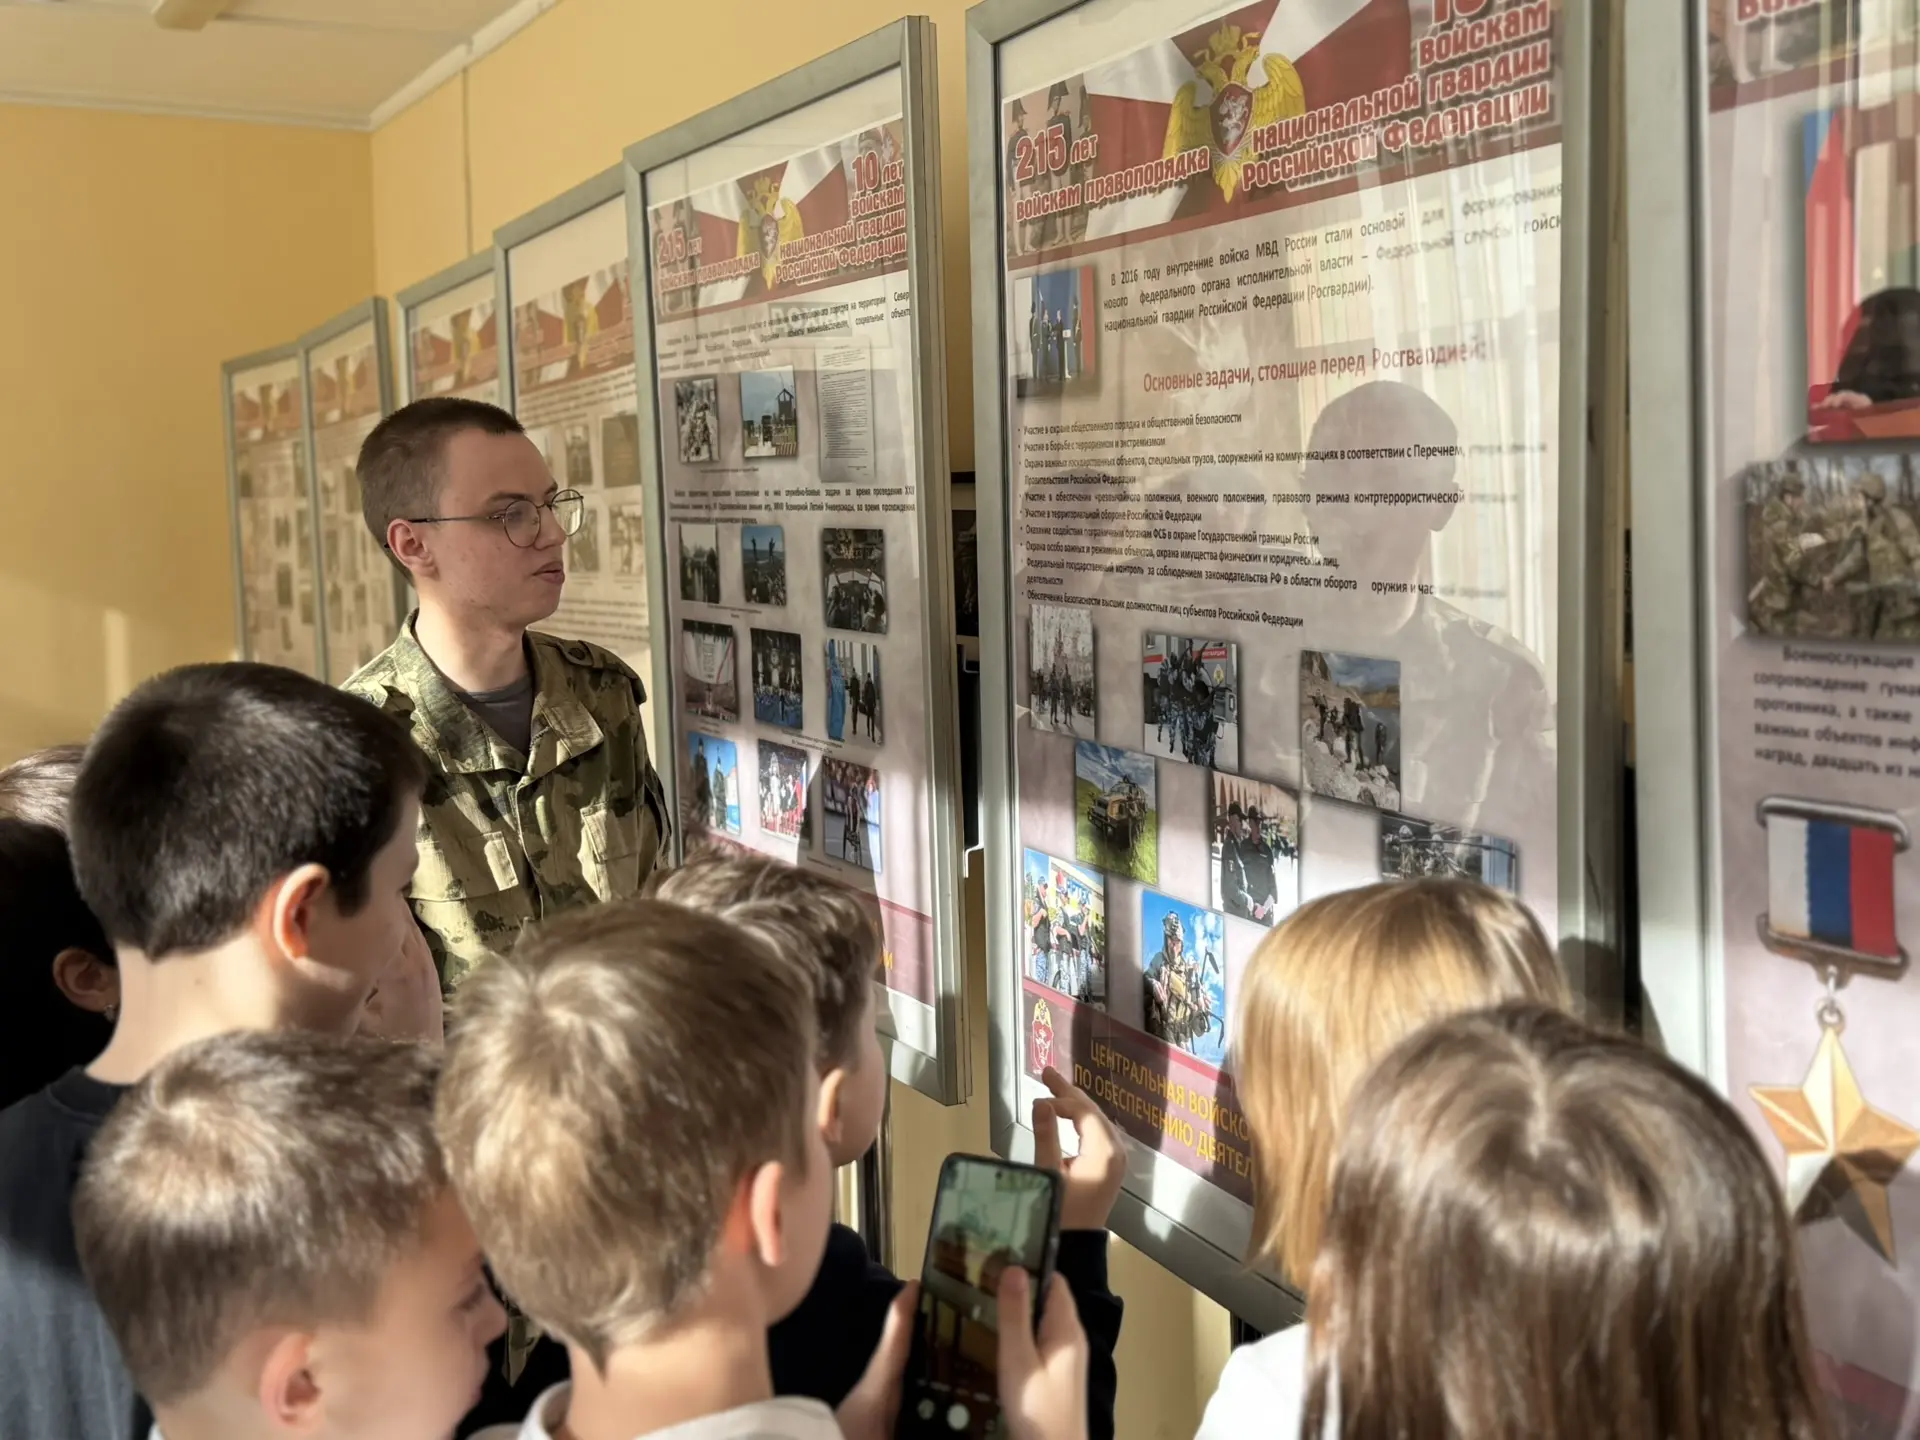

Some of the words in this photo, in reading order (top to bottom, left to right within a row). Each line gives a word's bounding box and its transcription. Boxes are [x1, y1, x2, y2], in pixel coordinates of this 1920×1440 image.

[1418, 0, 1550, 68] войскам
[1253, 74, 1421, 153] национальной
[1427, 38, 1550, 104] гвардии
[851, 151, 879, 192] 10
[882, 159, 904, 183] лет
[1016, 124, 1066, 181] 215
[1071, 134, 1098, 165] лет
[1242, 126, 1377, 191] Российской
[851, 185, 905, 218] войскам
[1016, 183, 1081, 222] войскам
[1085, 146, 1210, 203] правопорядка
[657, 228, 687, 266] 215
[780, 219, 855, 260] национальной
[857, 209, 906, 238] гвардии
[1121, 269, 1138, 284] 2016
[1143, 267, 1160, 281] году
[1166, 256, 1214, 277] внутренние
[1219, 248, 1250, 265] войска
[1256, 240, 1279, 258] МВД
[1285, 234, 1318, 251] России
[1325, 227, 1352, 244] стали
[1360, 212, 1405, 237] основой
[1104, 295, 1128, 310] нового
[1140, 284, 1196, 306] федерального
[1202, 279, 1231, 295] органа
[1237, 258, 1312, 287] исполнительной
[1320, 254, 1353, 271] власти
[1105, 310, 1158, 331] национальной
[1162, 308, 1194, 324] гвардии
[1199, 296, 1247, 317] Российской
[1253, 291, 1304, 310] Федерации
[1144, 371, 1202, 392] Основные
[1206, 367, 1254, 389] задачи,
[1258, 359, 1316, 381] стоящие
[1320, 354, 1366, 379] перед
[1147, 414, 1194, 429] общественной
[1195, 413, 1242, 425] безопасности
[1148, 455, 1191, 466] специальных
[1193, 454, 1216, 467] грузов,
[1217, 450, 1263, 465] сооружений
[1265, 453, 1274, 462] на
[1346, 447, 1405, 460] соответствии
[1144, 493, 1183, 504] положения,
[1187, 493, 1219, 503] военного
[1223, 493, 1267, 505] положения,
[1272, 493, 1311, 506] правового
[1316, 493, 1350, 506] режима
[1354, 489, 1465, 507] контртеррористической
[1165, 510, 1202, 523] Федерации
[1153, 528, 1166, 540] ФСБ
[1173, 531, 1196, 542] охране
[1198, 530, 1257, 544] Государственной
[1259, 534, 1291, 546] границы
[1293, 532, 1319, 545] России
[1156, 549, 1179, 560] охрана
[1180, 550, 1218, 561] имущества
[1219, 550, 1261, 563] физических
[1115, 565, 1145, 576] контроль
[1148, 566, 1155, 575] за
[1156, 565, 1203, 579] соблюдением
[1205, 570, 1268, 584] законодательства
[1270, 572, 1281, 584] РФ
[1290, 574, 1321, 587] области
[1324, 575, 1357, 591] оборота
[1371, 580, 1407, 595] оружия
[1126, 601, 1168, 613] должностных
[1169, 605, 1182, 615] лиц
[1183, 604, 1217, 618] субъектов
[1218, 607, 1260, 623] Российской
[1262, 612, 1304, 628] Федерации
[1864, 708, 1912, 724] также
[1815, 726, 1882, 747] объектов
[1811, 754, 1880, 774] двадцать
[1091, 1039, 1185, 1109] ЦЕНТРАЛЬНАЯ
[1074, 1064, 1092, 1090] ПО
[1095, 1077, 1193, 1148] ОБЕСПЕЧЕНИЮ
